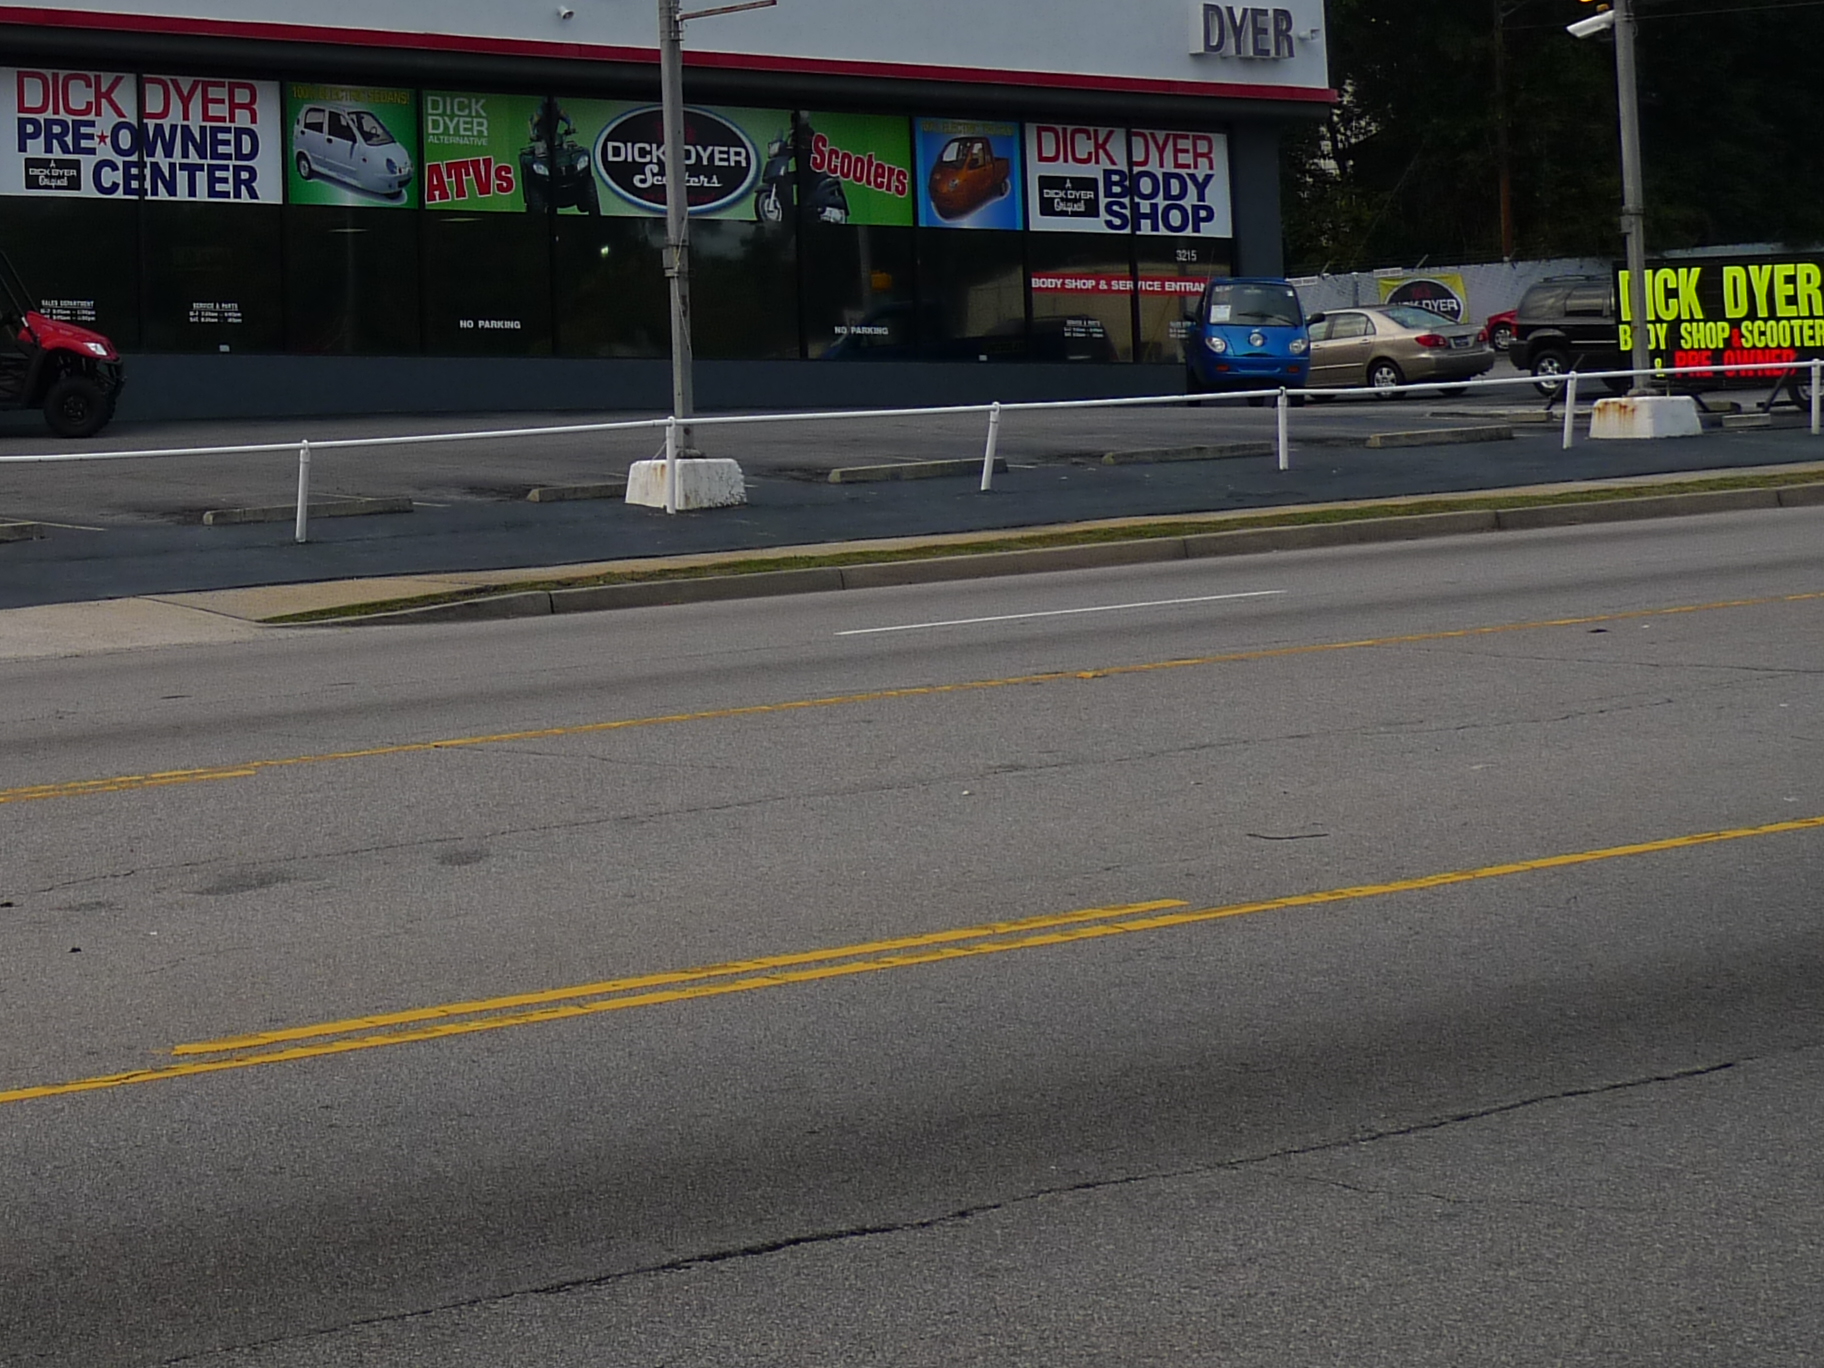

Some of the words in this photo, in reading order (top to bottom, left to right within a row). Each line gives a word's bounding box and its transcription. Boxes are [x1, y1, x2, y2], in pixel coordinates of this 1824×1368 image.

[1202, 3, 1295, 58] DYER
[16, 70, 128, 119] DICK
[142, 76, 258, 125] DYER
[427, 96, 487, 117] DICK
[428, 115, 488, 137] DYER
[428, 135, 489, 146] ALTERNATIVE
[607, 141, 666, 163] DICK
[683, 145, 747, 167] DYER
[1036, 126, 1118, 167] DICK
[1132, 131, 1215, 171] DYER
[92, 158, 260, 200] CENTER
[425, 155, 515, 204] ATVs
[633, 163, 723, 189] Scters
[810, 132, 909, 198] Scooters
[1043, 189, 1066, 198] DICK
[1067, 190, 1094, 200] DYER
[1103, 168, 1215, 203] BODY
[1103, 200, 1215, 234] SHOP
[1176, 250, 1197, 262] 3215
[1031, 278, 1062, 289] BODY
[1064, 278, 1096, 290] SHOP
[1098, 279, 1108, 290] &
[1722, 263, 1824, 319] DYER
[459, 319, 474, 329] NO
[478, 319, 521, 329] PARKING
[834, 326, 847, 335] NO
[851, 326, 889, 335] PARKING
[1618, 322, 1668, 351] BDY
[1680, 321, 1730, 350] SHOP
[1674, 349, 1714, 378] PRE
